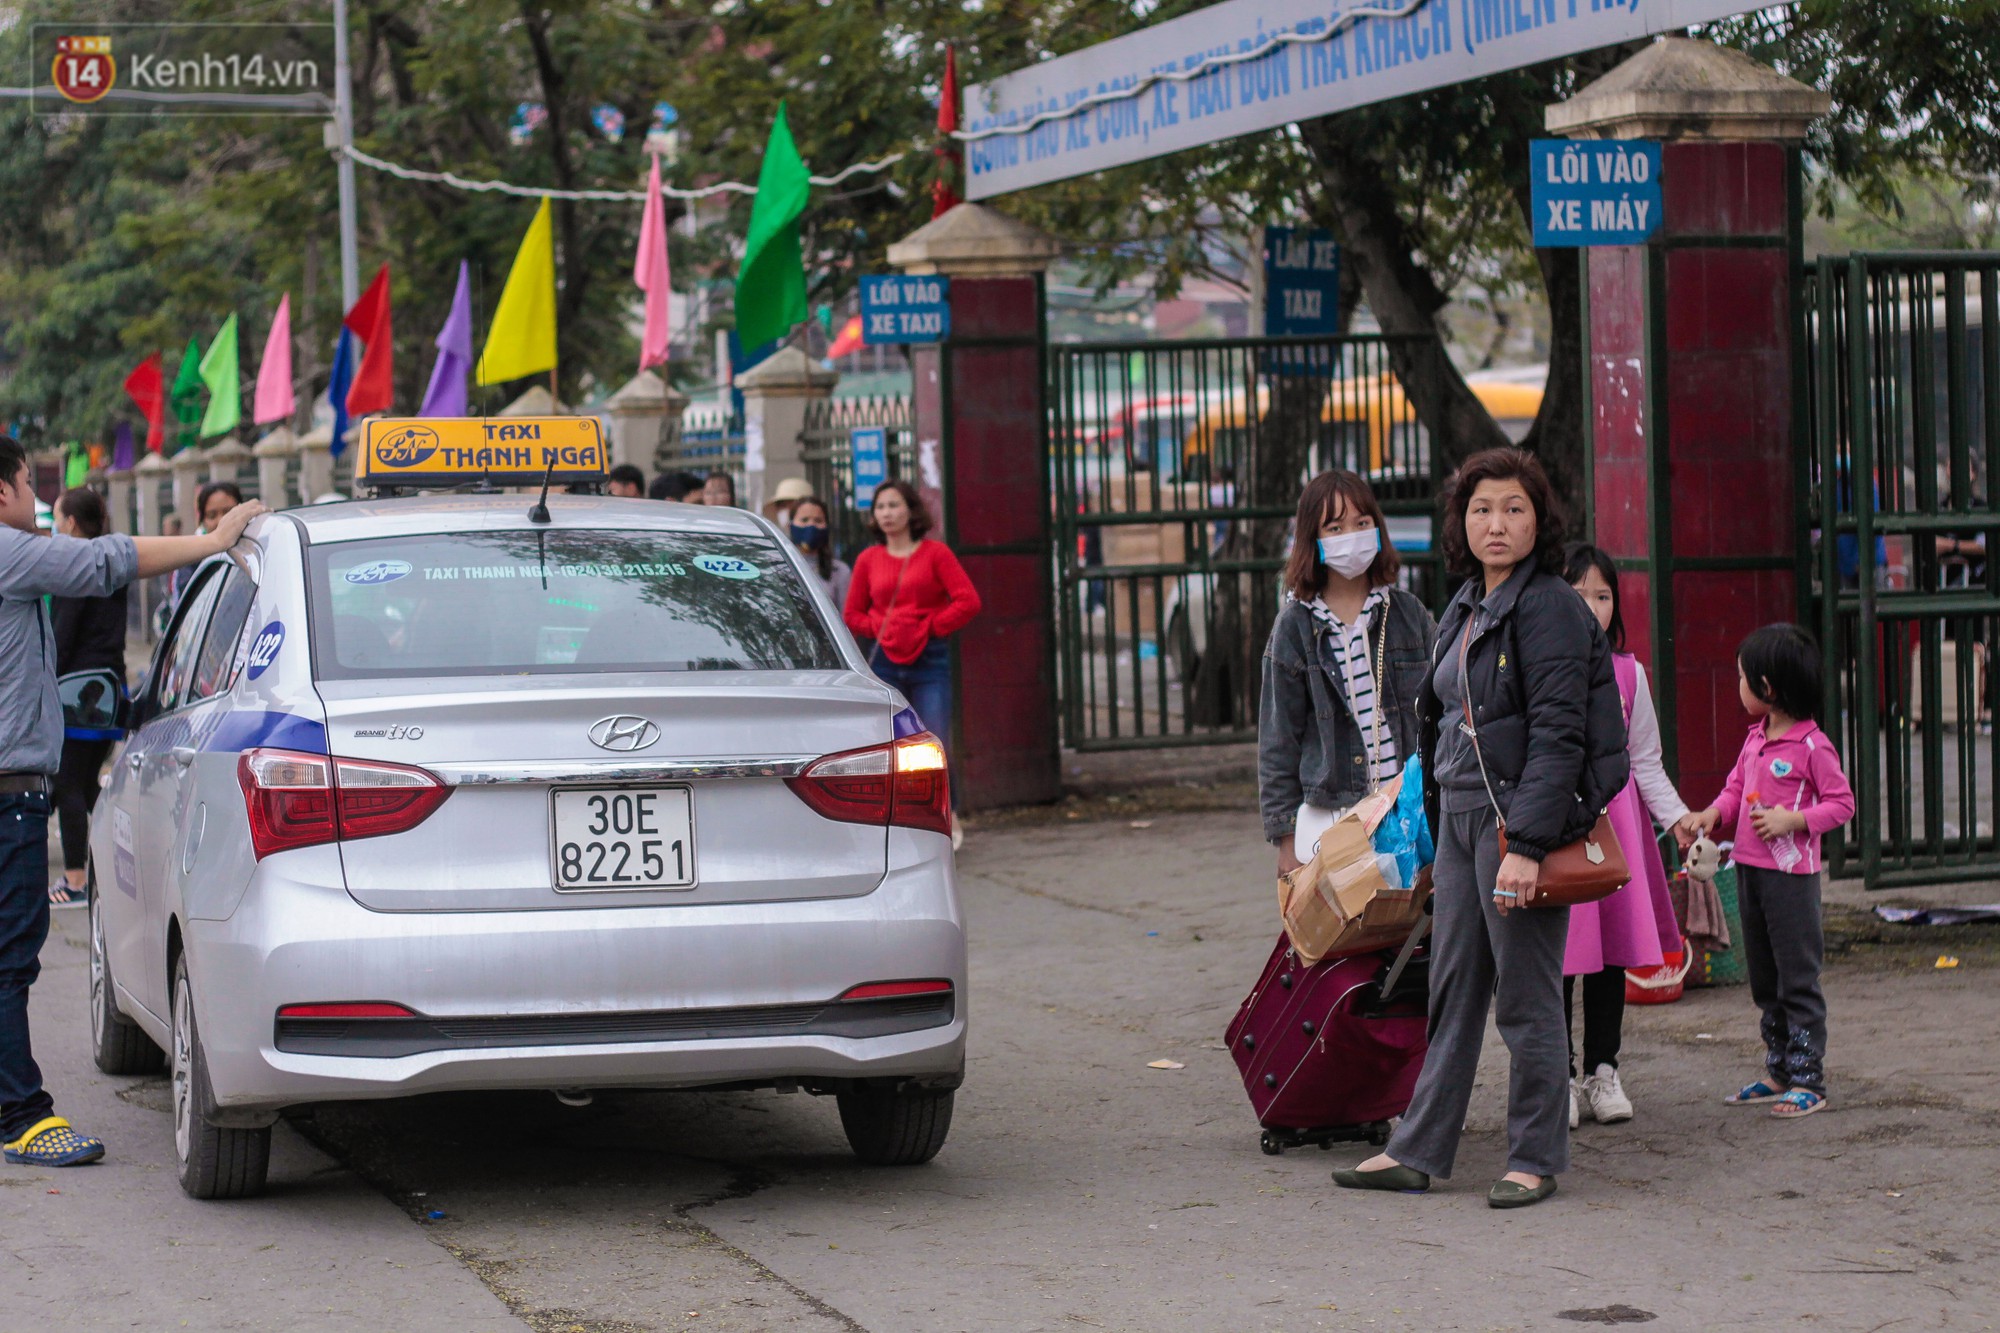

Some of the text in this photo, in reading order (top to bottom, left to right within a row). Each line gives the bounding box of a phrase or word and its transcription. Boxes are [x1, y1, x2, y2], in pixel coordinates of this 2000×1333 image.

[1065, 87, 1090, 152] XE
[1151, 61, 1179, 130] XE
[1184, 44, 1230, 120] TAXI
[1546, 142, 1650, 184] LỐI VÀO
[1546, 191, 1650, 231] XE MÁY
[1313, 240, 1336, 271] XE
[869, 277, 941, 306] LỐI VÀO
[1282, 289, 1322, 319] TAXI
[870, 312, 942, 335] XE TAXI
[482, 424, 541, 440] TAXI
[440, 446, 596, 468] THANH NGA
[423, 567, 460, 581] TAXI
[462, 565, 516, 580] THANH
[703, 561, 750, 572] 422
[250, 633, 282, 668] 422
[388, 723, 424, 741] i10
[587, 794, 659, 836] 30E
[561, 839, 684, 883] 822.51
